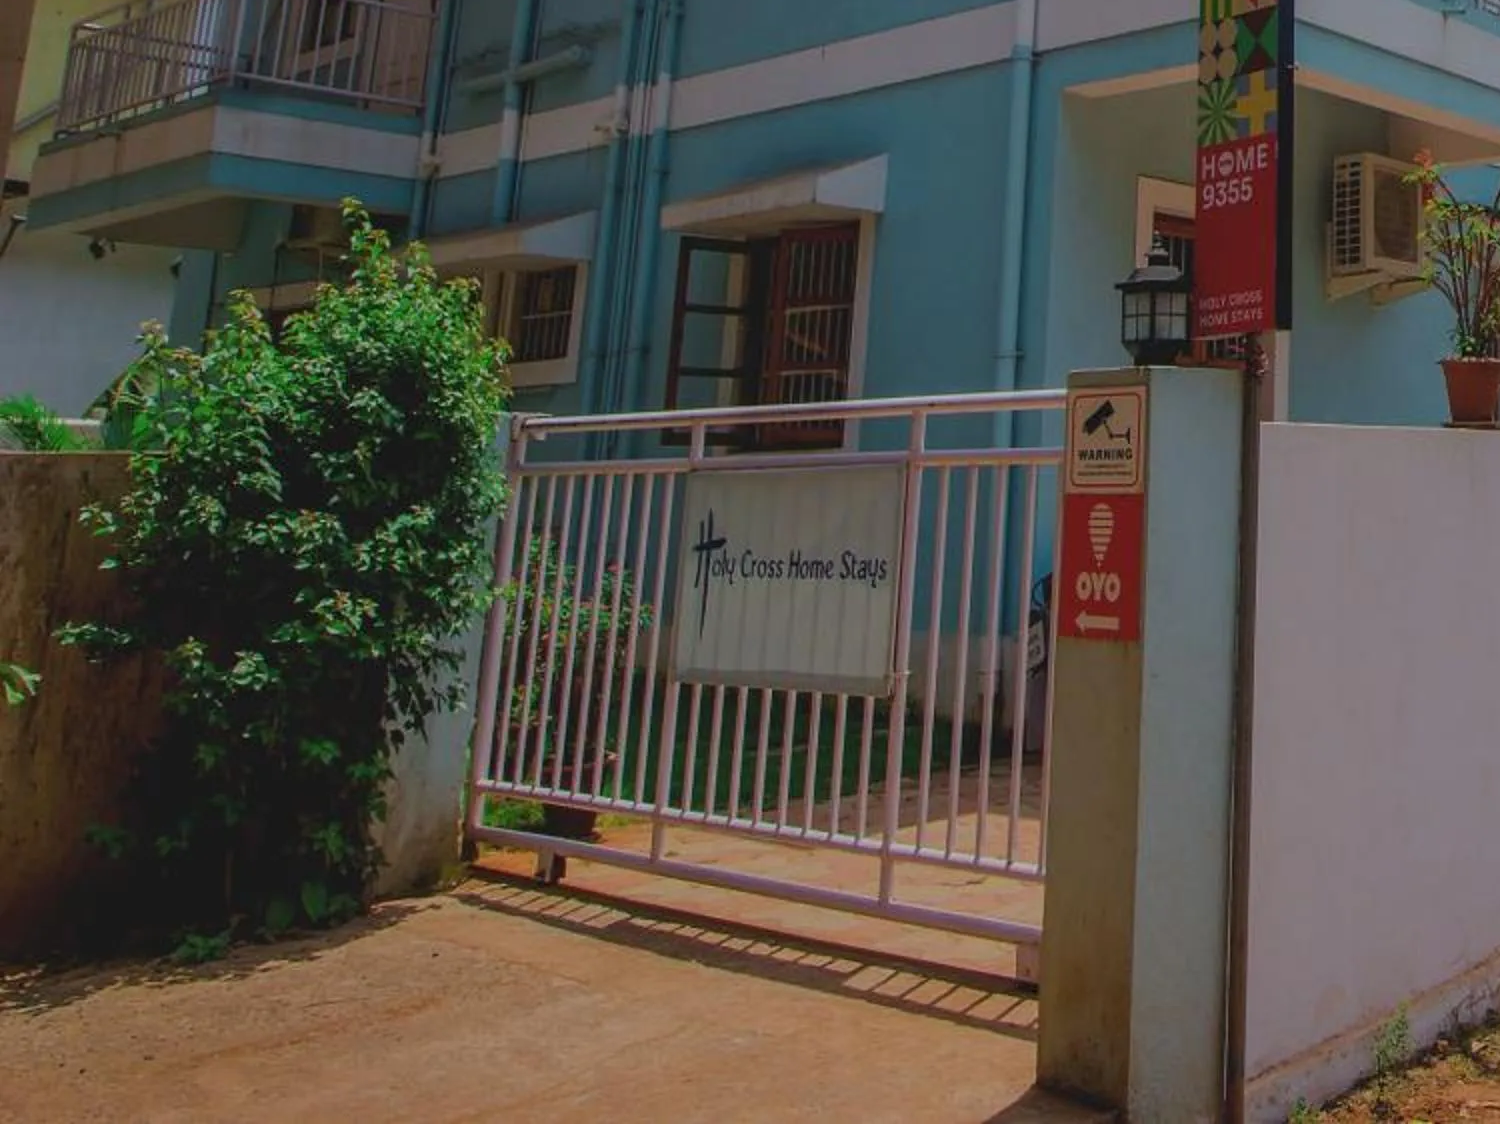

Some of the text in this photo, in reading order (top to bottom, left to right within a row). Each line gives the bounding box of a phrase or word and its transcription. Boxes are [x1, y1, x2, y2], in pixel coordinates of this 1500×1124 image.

[1202, 143, 1268, 181] HOME
[1203, 177, 1253, 209] 9355
[1199, 294, 1227, 310] HOLY
[1199, 311, 1228, 327] HOME
[1078, 447, 1133, 461] WARNING
[692, 508, 887, 640] Holy Cross Home Stays
[1076, 572, 1121, 602] OYO
